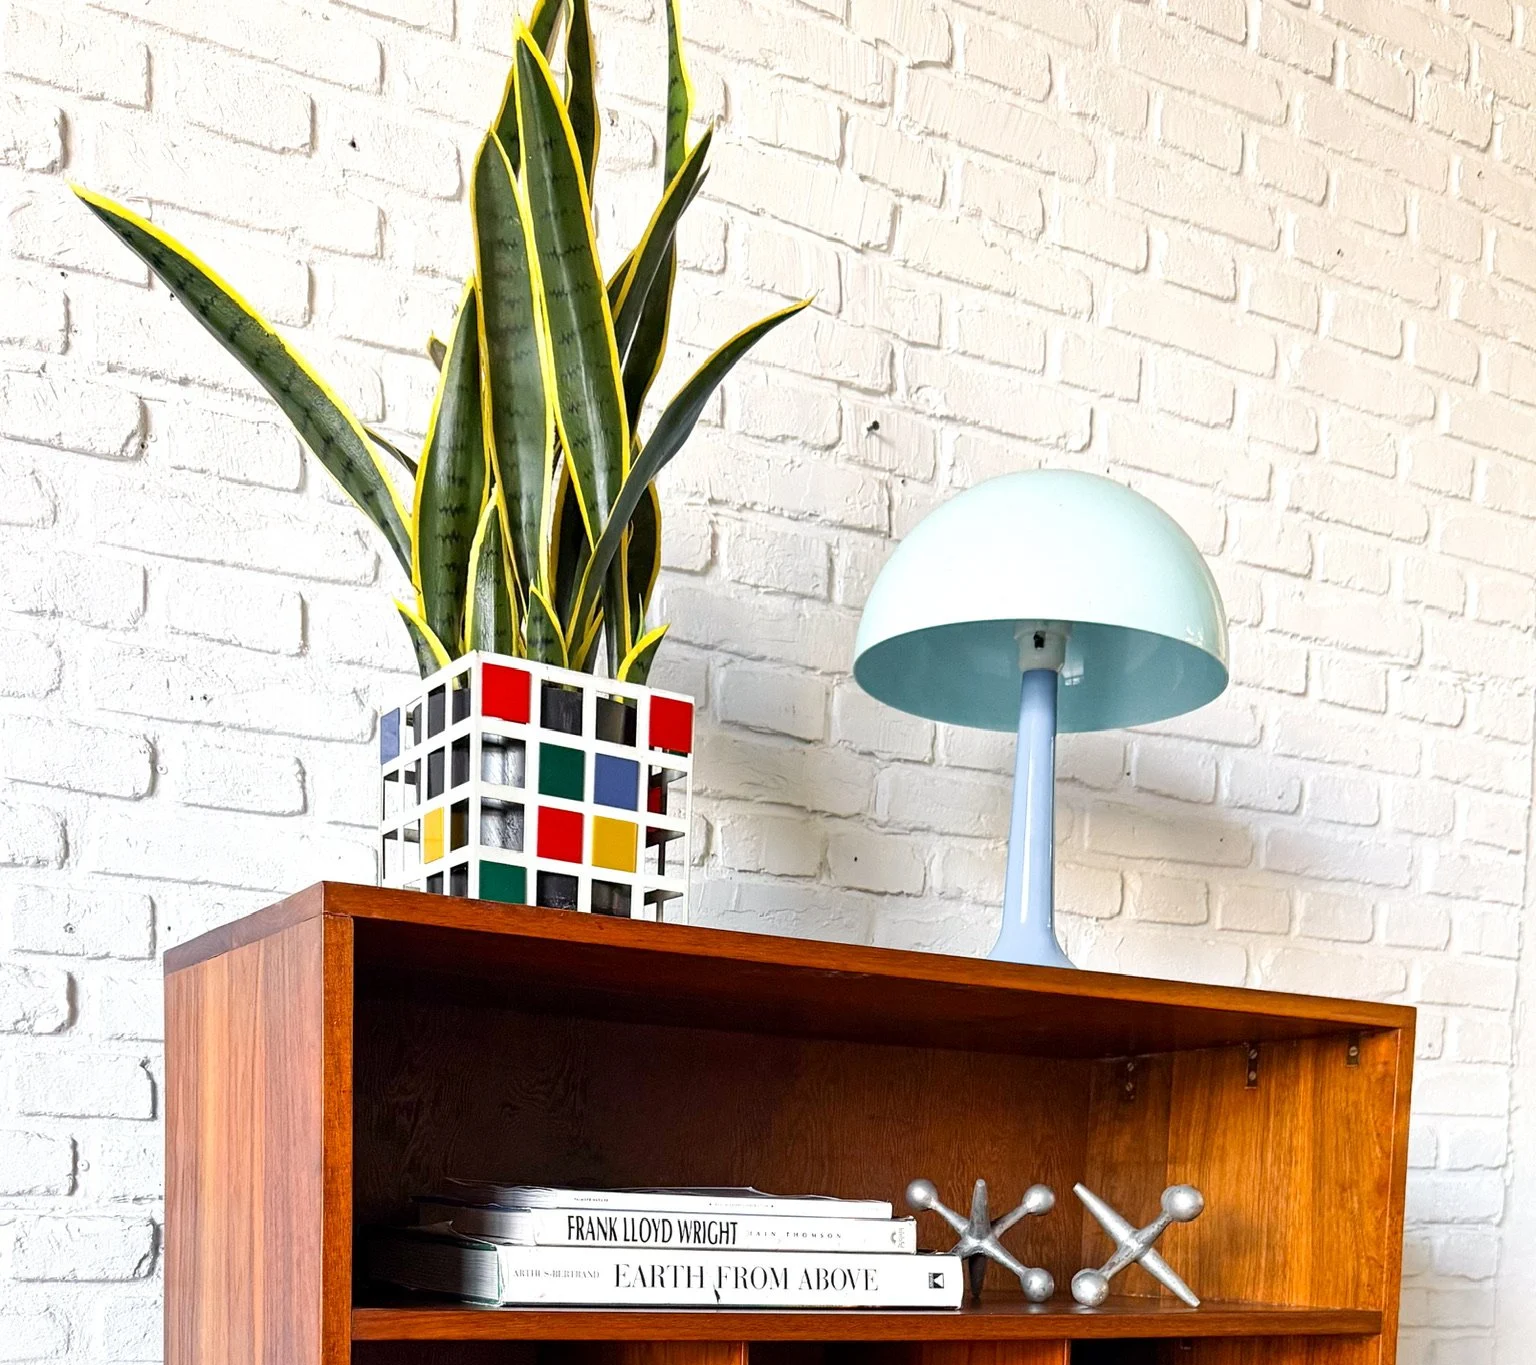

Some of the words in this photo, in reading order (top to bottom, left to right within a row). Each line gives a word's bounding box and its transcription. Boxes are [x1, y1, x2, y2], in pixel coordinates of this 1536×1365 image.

[567, 1215, 618, 1242] FRANK
[623, 1217, 673, 1243] LLOYD
[677, 1219, 738, 1245] WRIGHT
[749, 1230, 777, 1238] IAIN
[786, 1231, 842, 1239] THOMSON
[614, 1263, 705, 1289] EARTH
[717, 1265, 788, 1290] FROM
[798, 1267, 879, 1291] ABOVE
